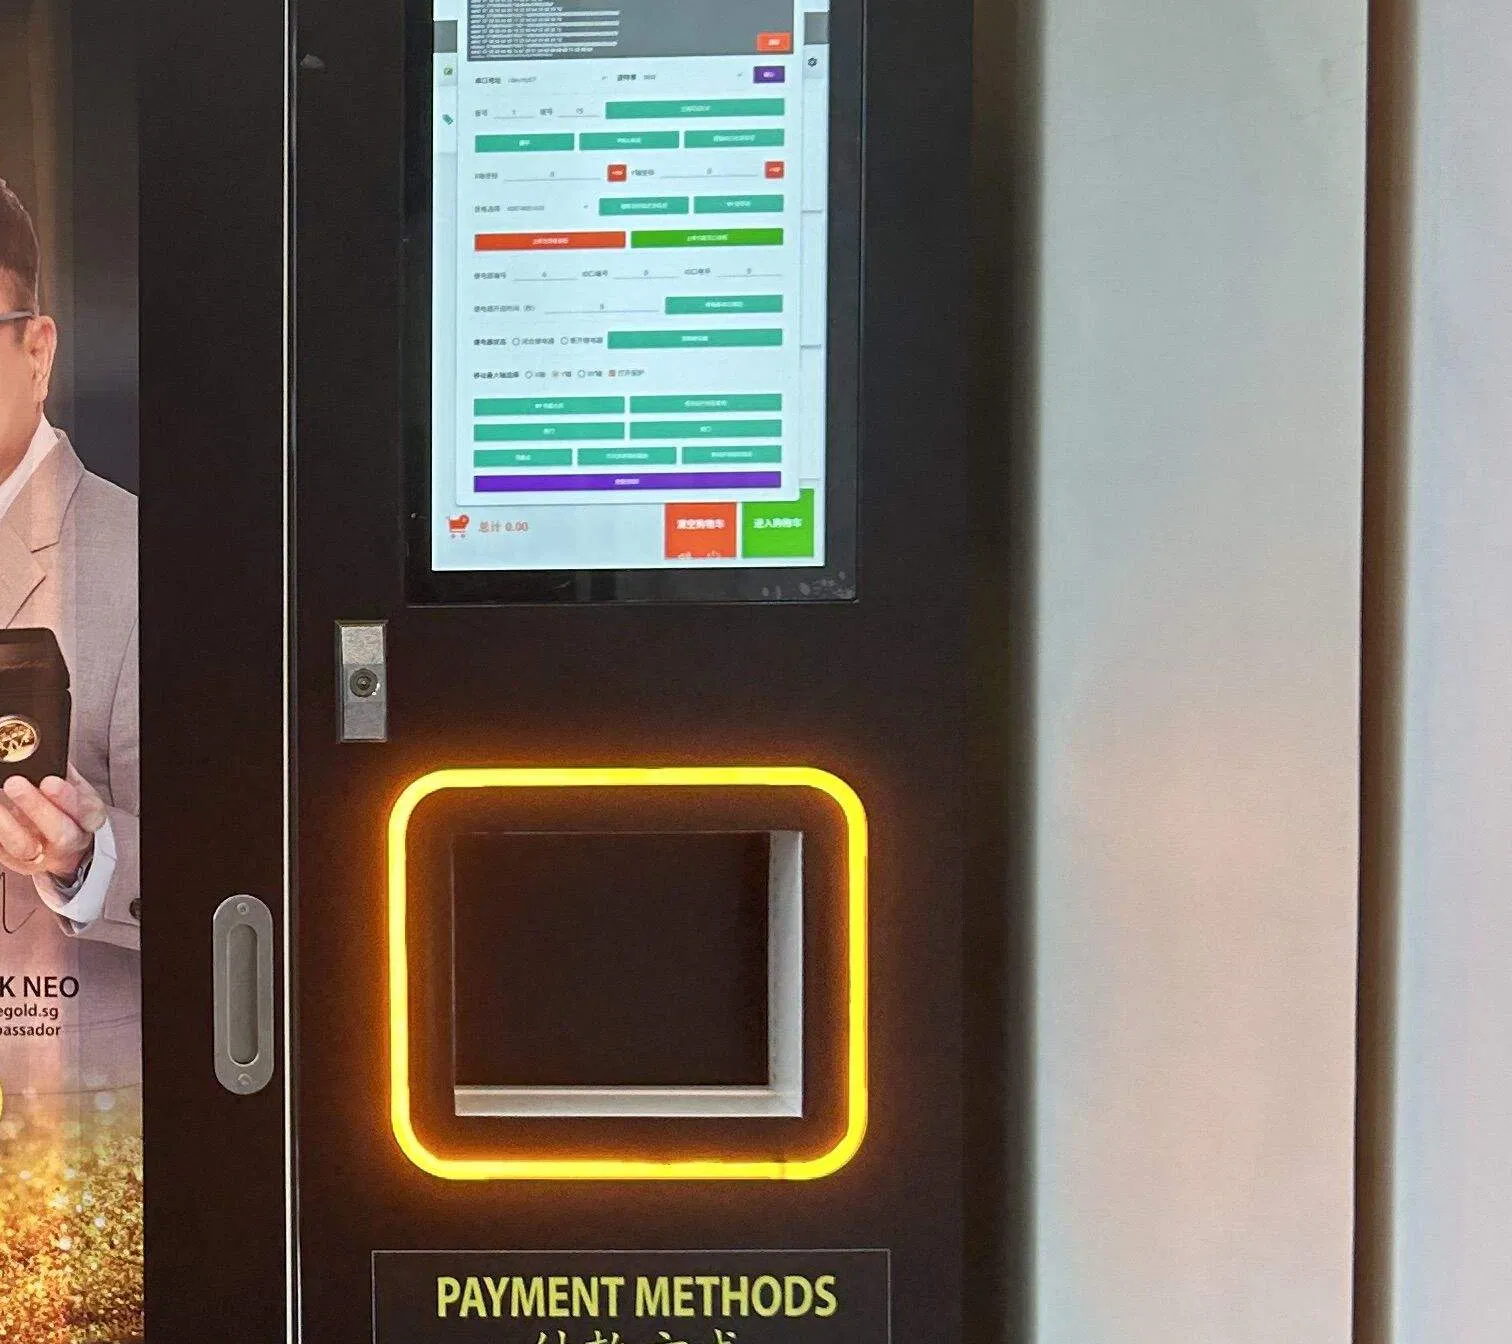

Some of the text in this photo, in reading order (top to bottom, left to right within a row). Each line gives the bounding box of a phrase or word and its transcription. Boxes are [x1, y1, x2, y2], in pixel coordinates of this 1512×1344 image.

[23, 976, 80, 998] NEO
[436, 1275, 838, 1318] PAYMENT METHODS
